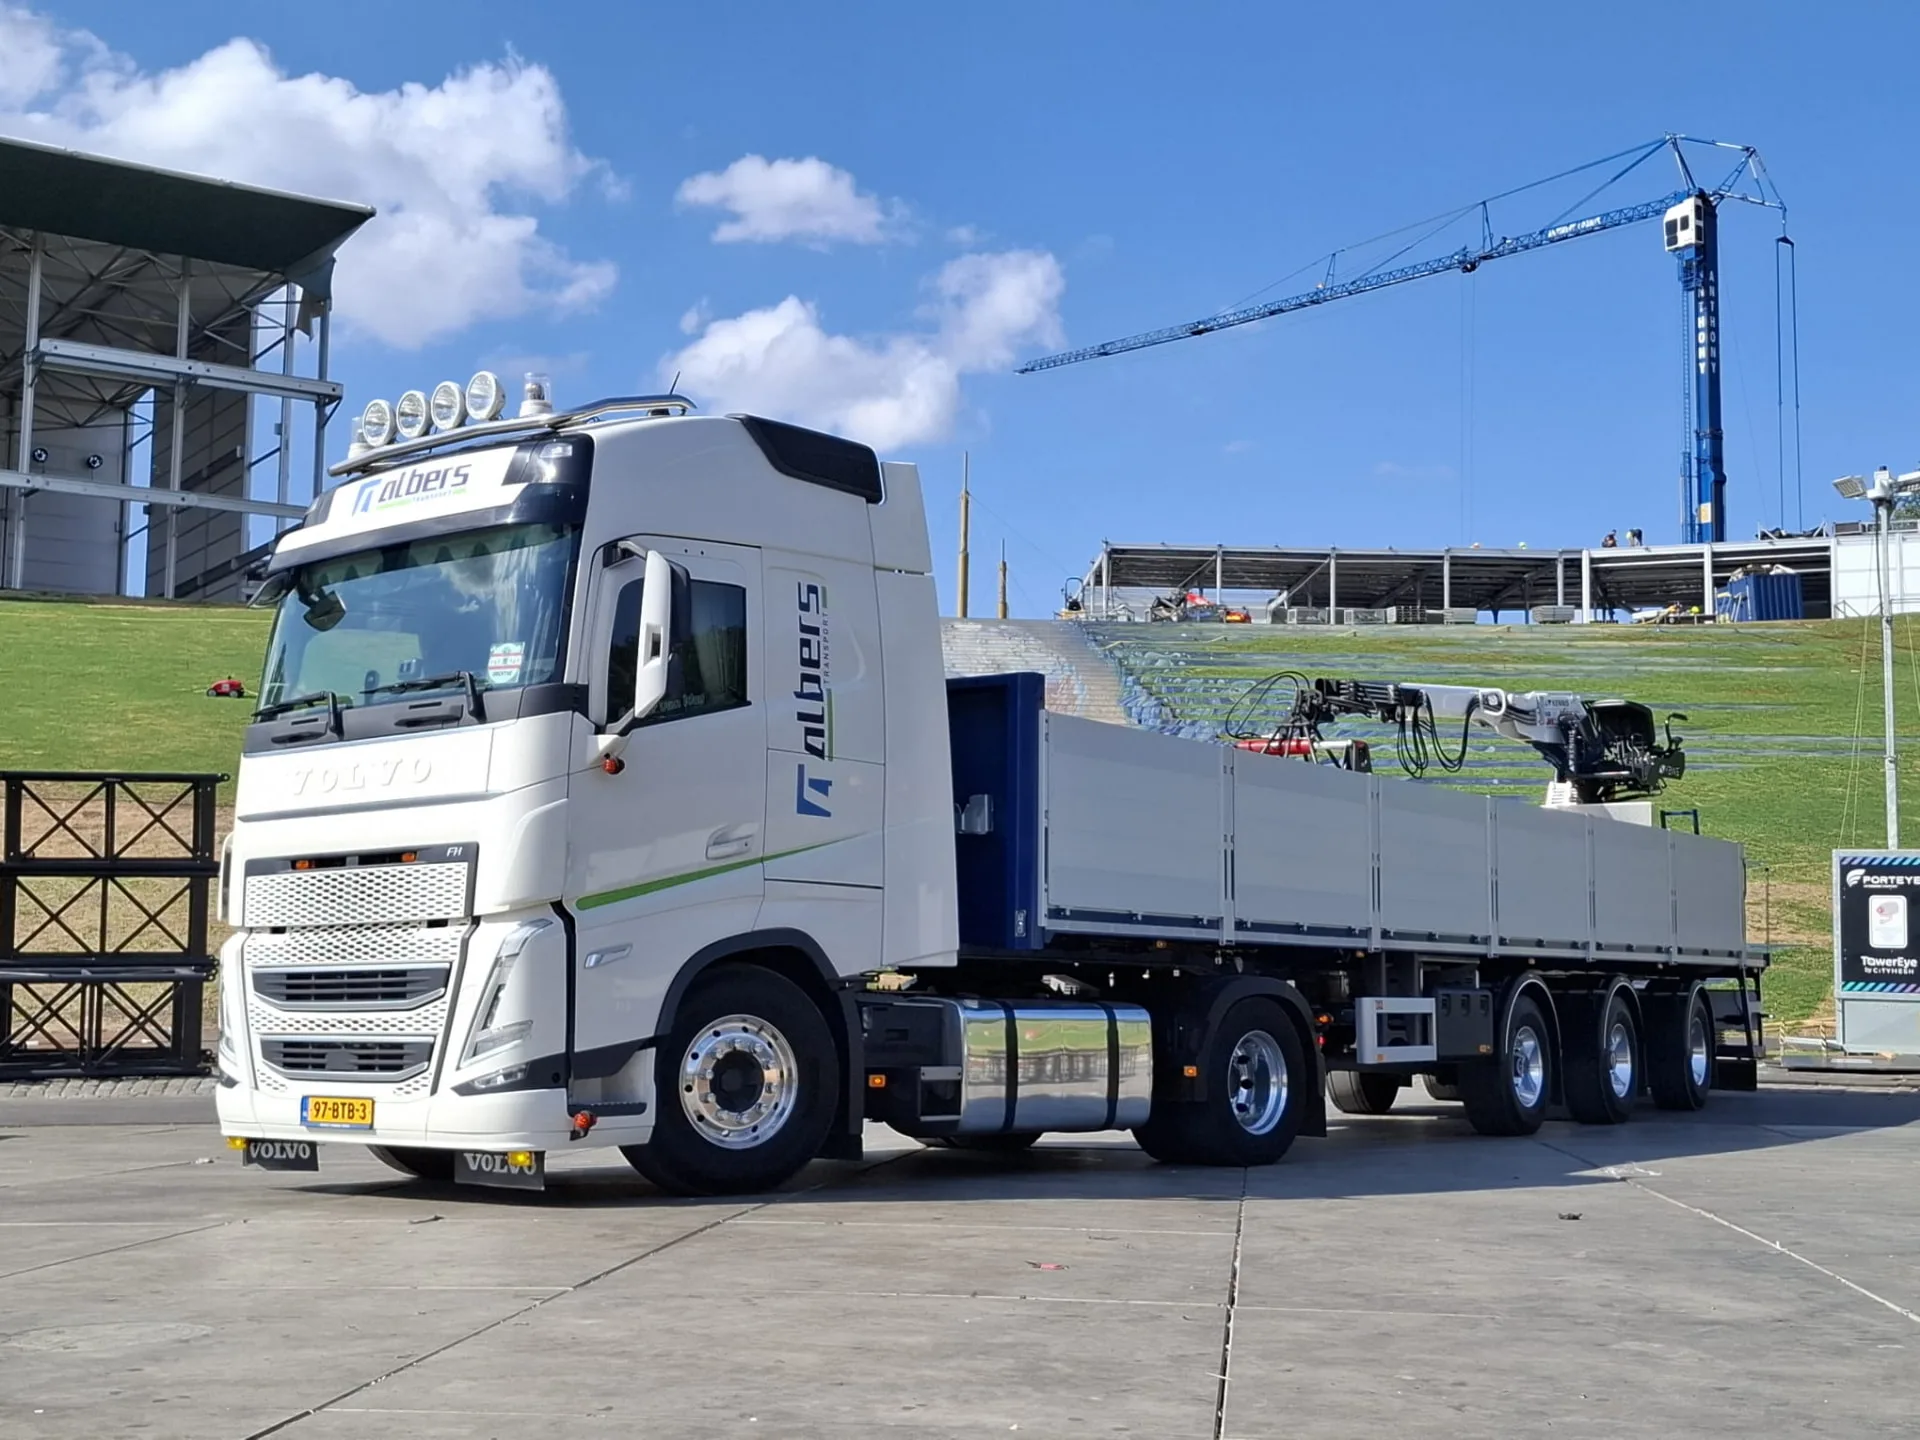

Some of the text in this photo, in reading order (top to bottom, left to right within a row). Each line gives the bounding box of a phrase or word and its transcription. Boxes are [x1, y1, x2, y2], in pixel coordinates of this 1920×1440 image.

[1709, 271, 1717, 373] ANTHONY
[287, 758, 432, 796] VOLVO
[446, 846, 463, 858] FH
[1860, 955, 1918, 969] TowerEye
[313, 1100, 367, 1121] 97-BTB-3
[250, 1142, 311, 1159] VOLVO
